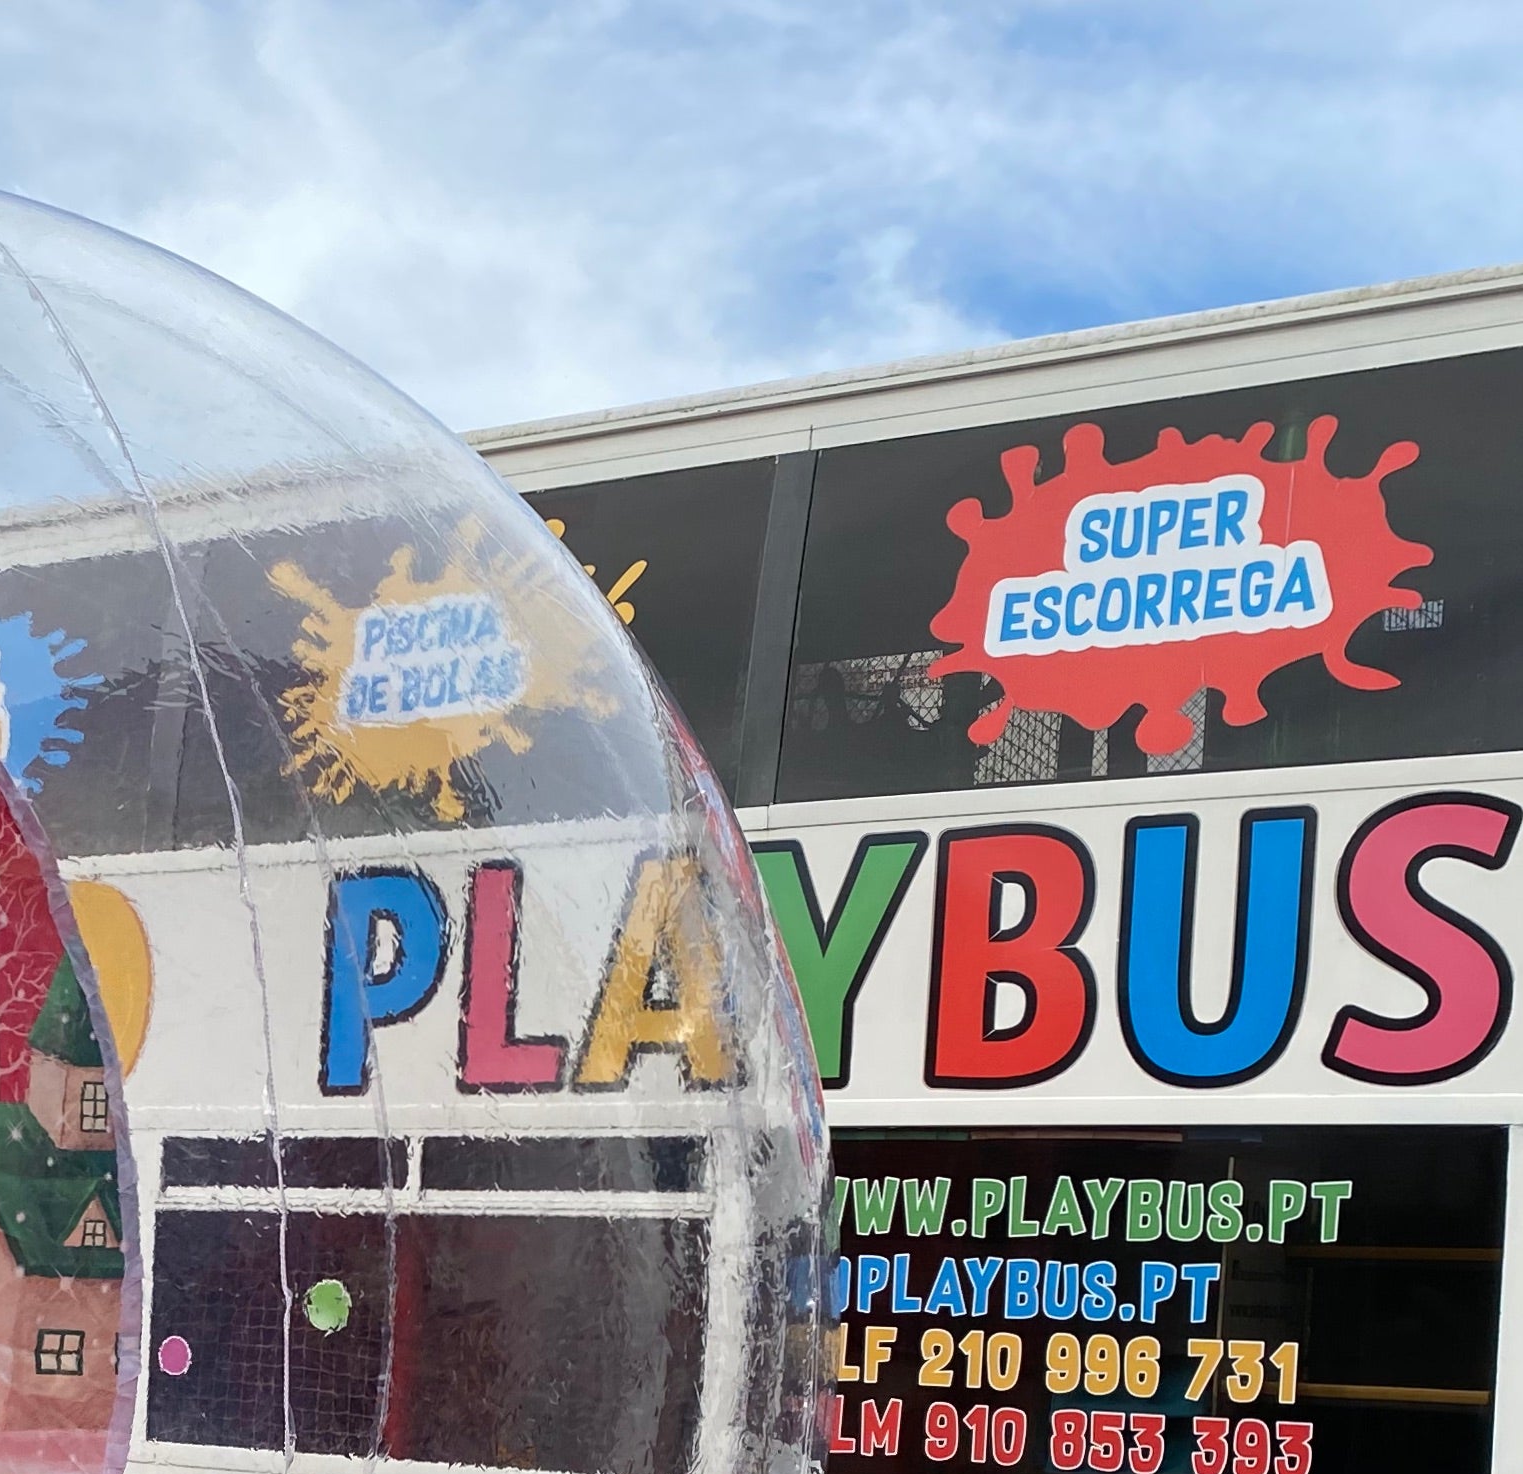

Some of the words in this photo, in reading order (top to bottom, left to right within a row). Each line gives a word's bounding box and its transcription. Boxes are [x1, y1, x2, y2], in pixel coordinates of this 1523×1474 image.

[1078, 489, 1248, 563] SUPER
[998, 555, 1315, 643] ESCORREGA
[347, 673, 389, 719] DE
[319, 790, 1522, 1097] PLAYBUS
[834, 1252, 1222, 1324] PLAYBUS.PT
[828, 1322, 898, 1385] LF
[917, 1328, 1022, 1392] 210
[1045, 1333, 1162, 1399] 996
[1184, 1339, 1300, 1406] 731
[826, 1394, 903, 1457] LM
[924, 1401, 1028, 1467] 910
